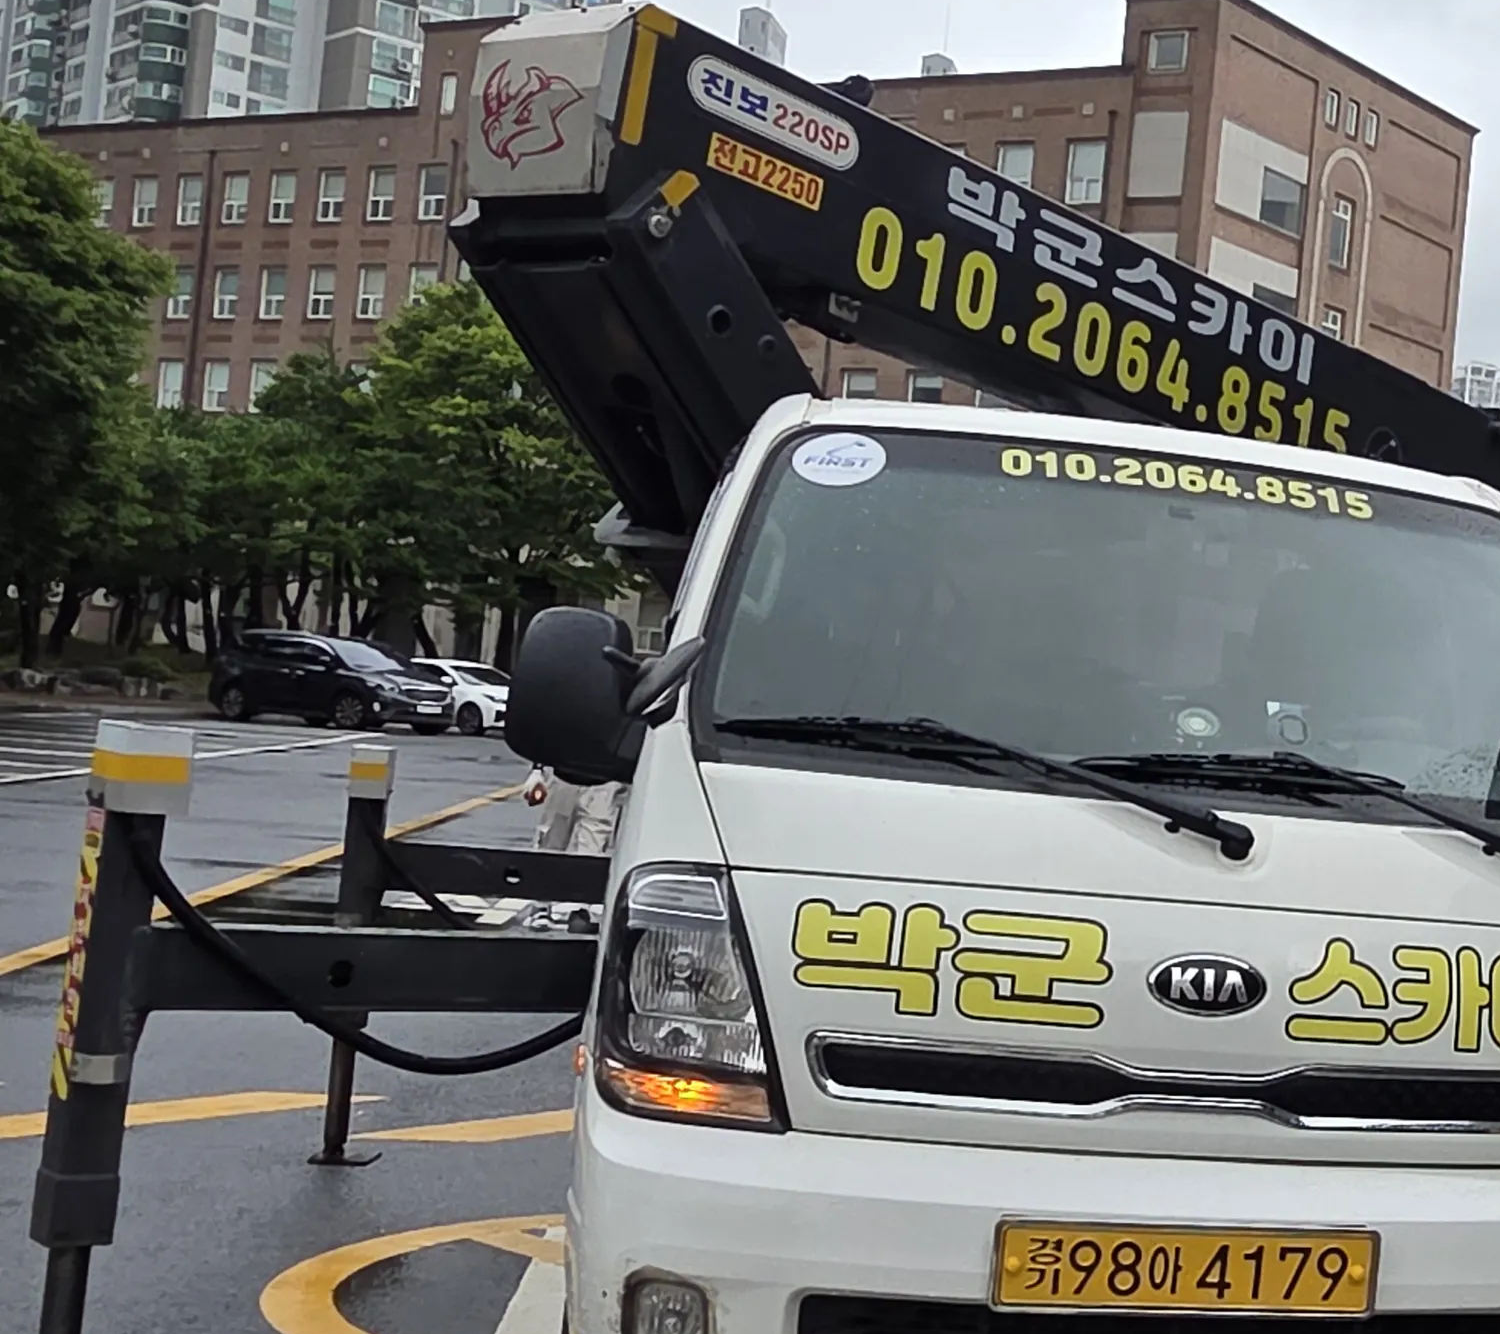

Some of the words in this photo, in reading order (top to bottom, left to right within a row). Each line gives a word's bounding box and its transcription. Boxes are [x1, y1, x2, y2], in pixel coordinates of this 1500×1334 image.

[947, 166, 1315, 386] 박군스카이
[856, 206, 1351, 455] 010.2064.8515
[803, 454, 875, 468] FIRST
[1001, 448, 1374, 519] 010.2064.8515
[792, 898, 1114, 1028] 박군
[1170, 966, 1249, 1003] KIA
[1196, 1244, 1349, 1302] 4179
